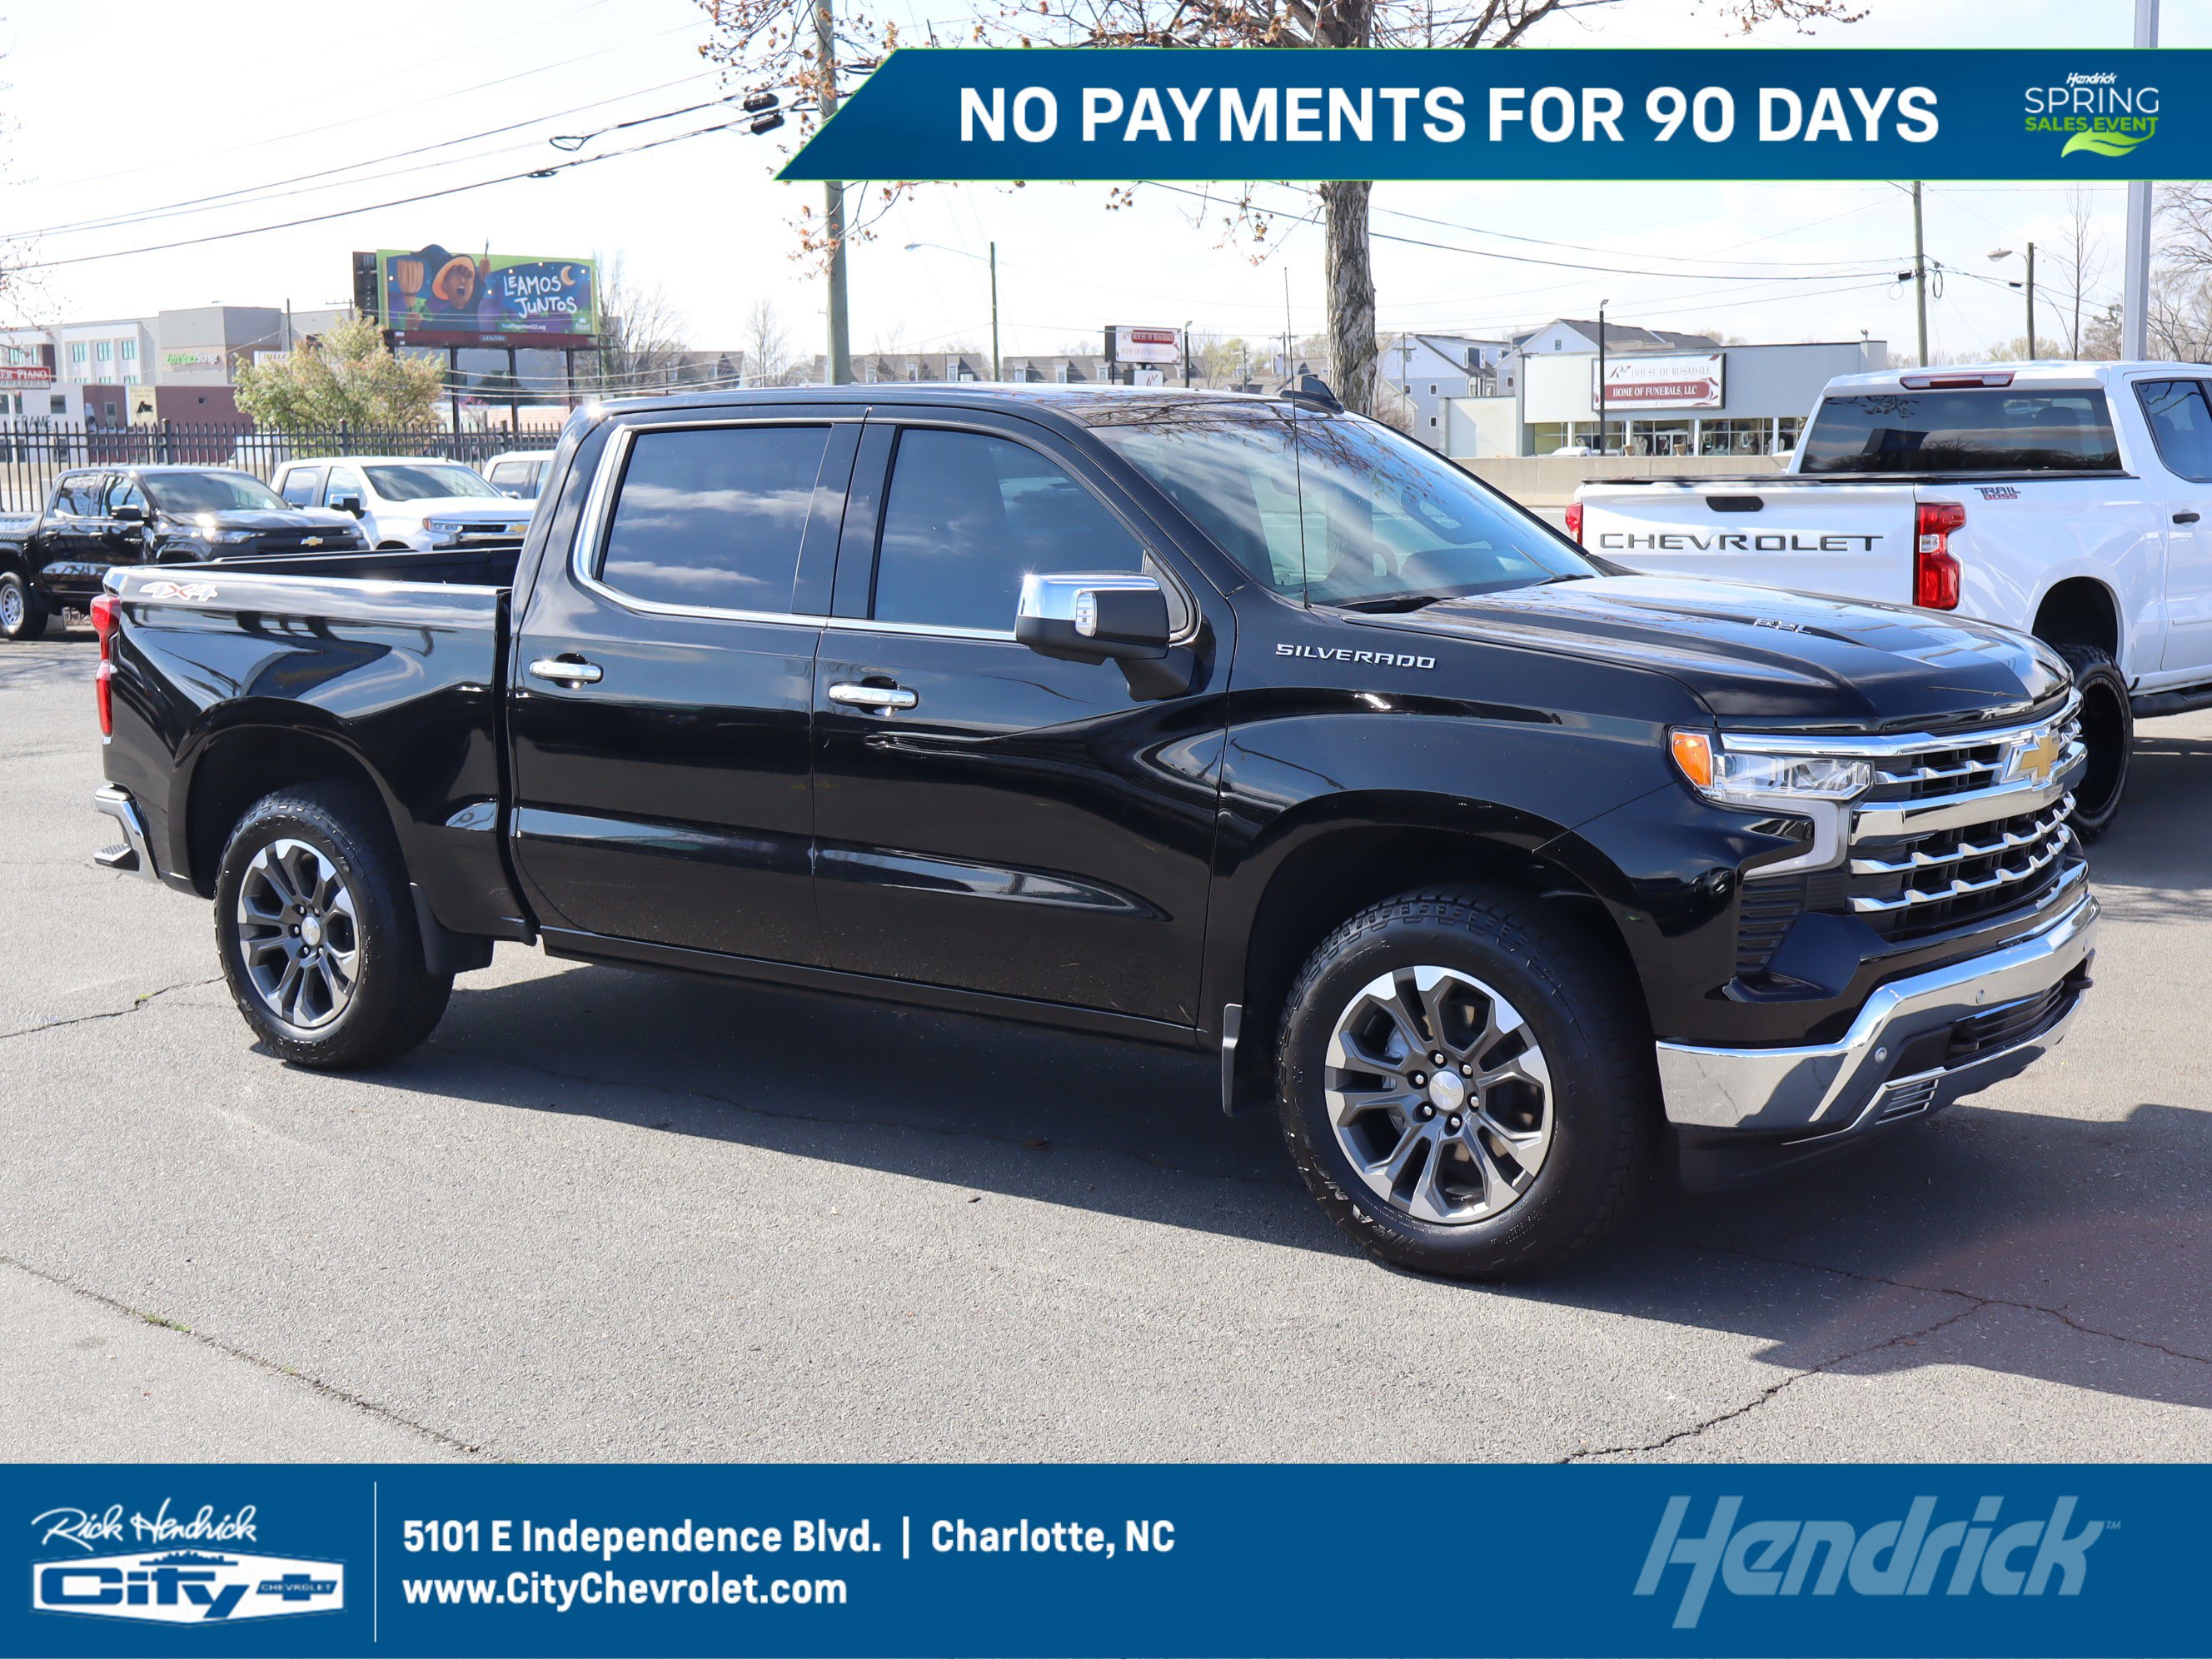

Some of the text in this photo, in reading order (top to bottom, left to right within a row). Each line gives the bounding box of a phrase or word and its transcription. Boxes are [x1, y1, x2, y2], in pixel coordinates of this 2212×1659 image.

[503, 276, 561, 296] LEAMOS
[514, 296, 577, 318] JUNTOS
[17, 369, 47, 380] PIANO
[1632, 366, 1656, 377] HOUSE
[1657, 367, 1668, 376] OF
[1672, 366, 1711, 376] ROSADALE
[1612, 385, 1697, 397] HOME OF FUNERALS, LLC
[1974, 486, 2021, 495] TRAIL
[1600, 533, 1884, 551] CHEVROLET
[1276, 644, 1437, 669] SILVERADO
